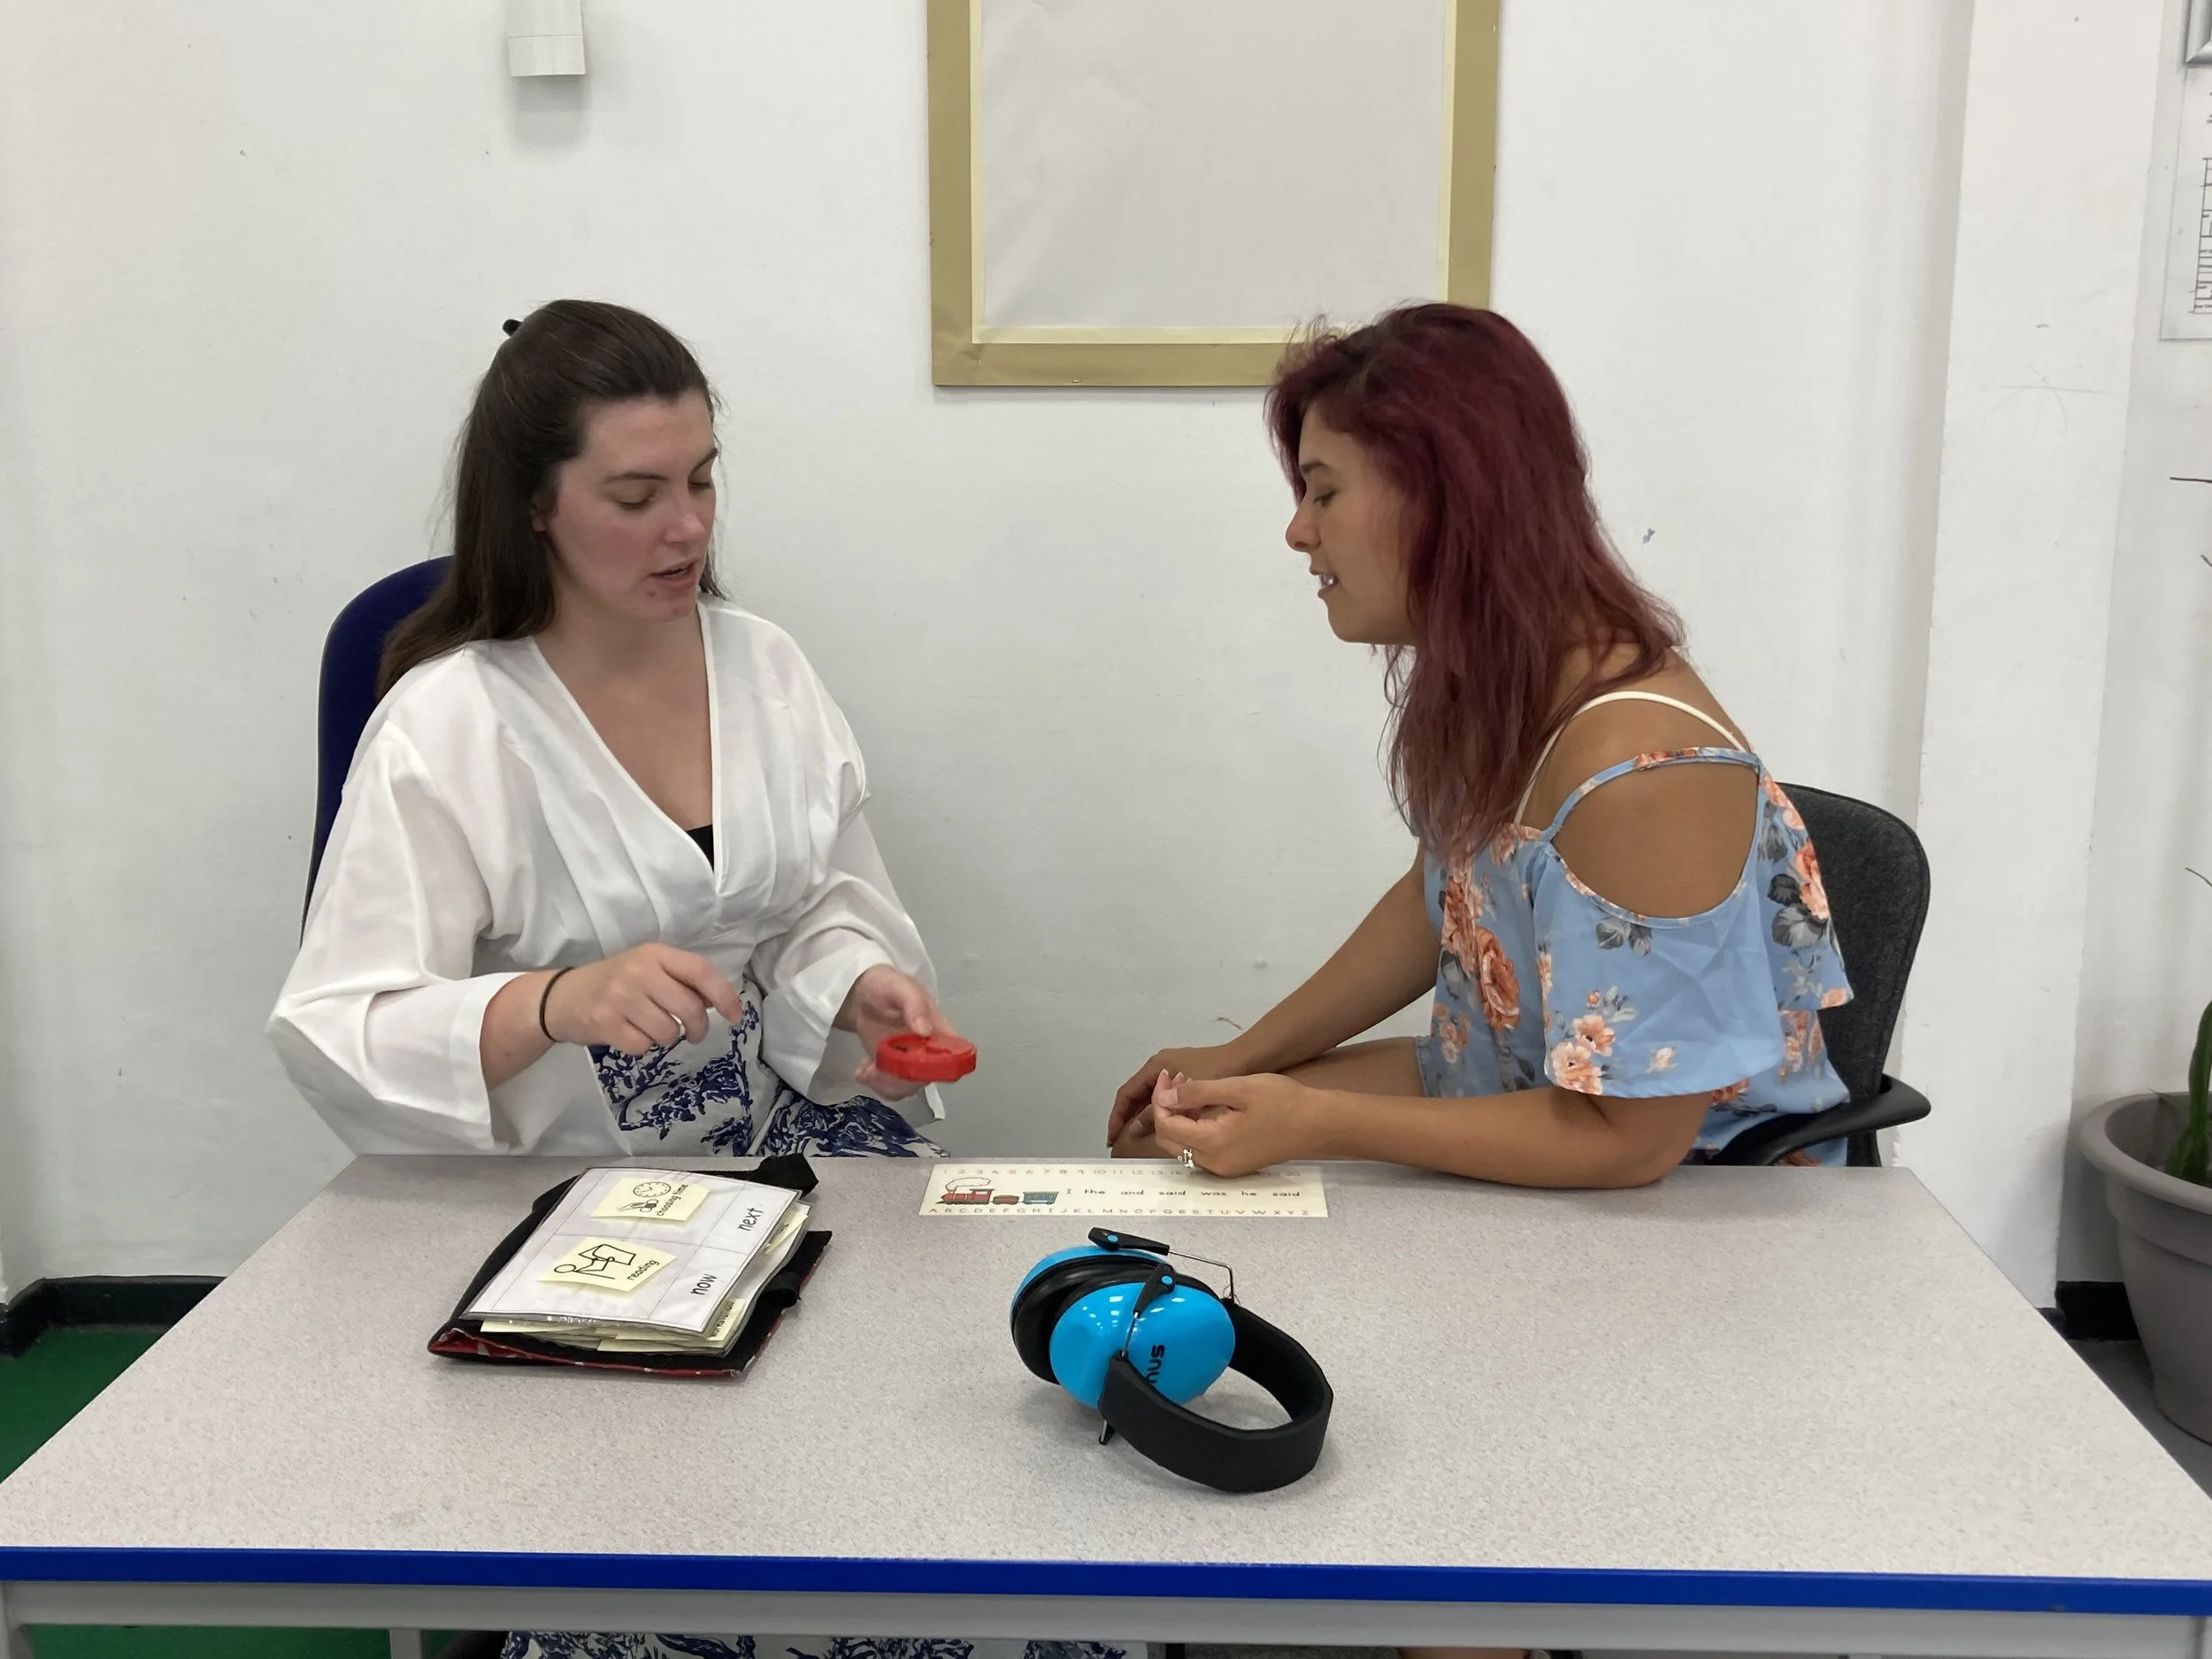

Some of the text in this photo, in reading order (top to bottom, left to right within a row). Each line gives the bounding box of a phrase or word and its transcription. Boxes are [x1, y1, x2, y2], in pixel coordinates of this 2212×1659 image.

[655, 1184, 689, 1217] choosing time
[737, 1207, 764, 1231] next
[626, 1259, 660, 1280] reading
[690, 1273, 718, 1295] now
[1146, 1344, 1165, 1385] snu
